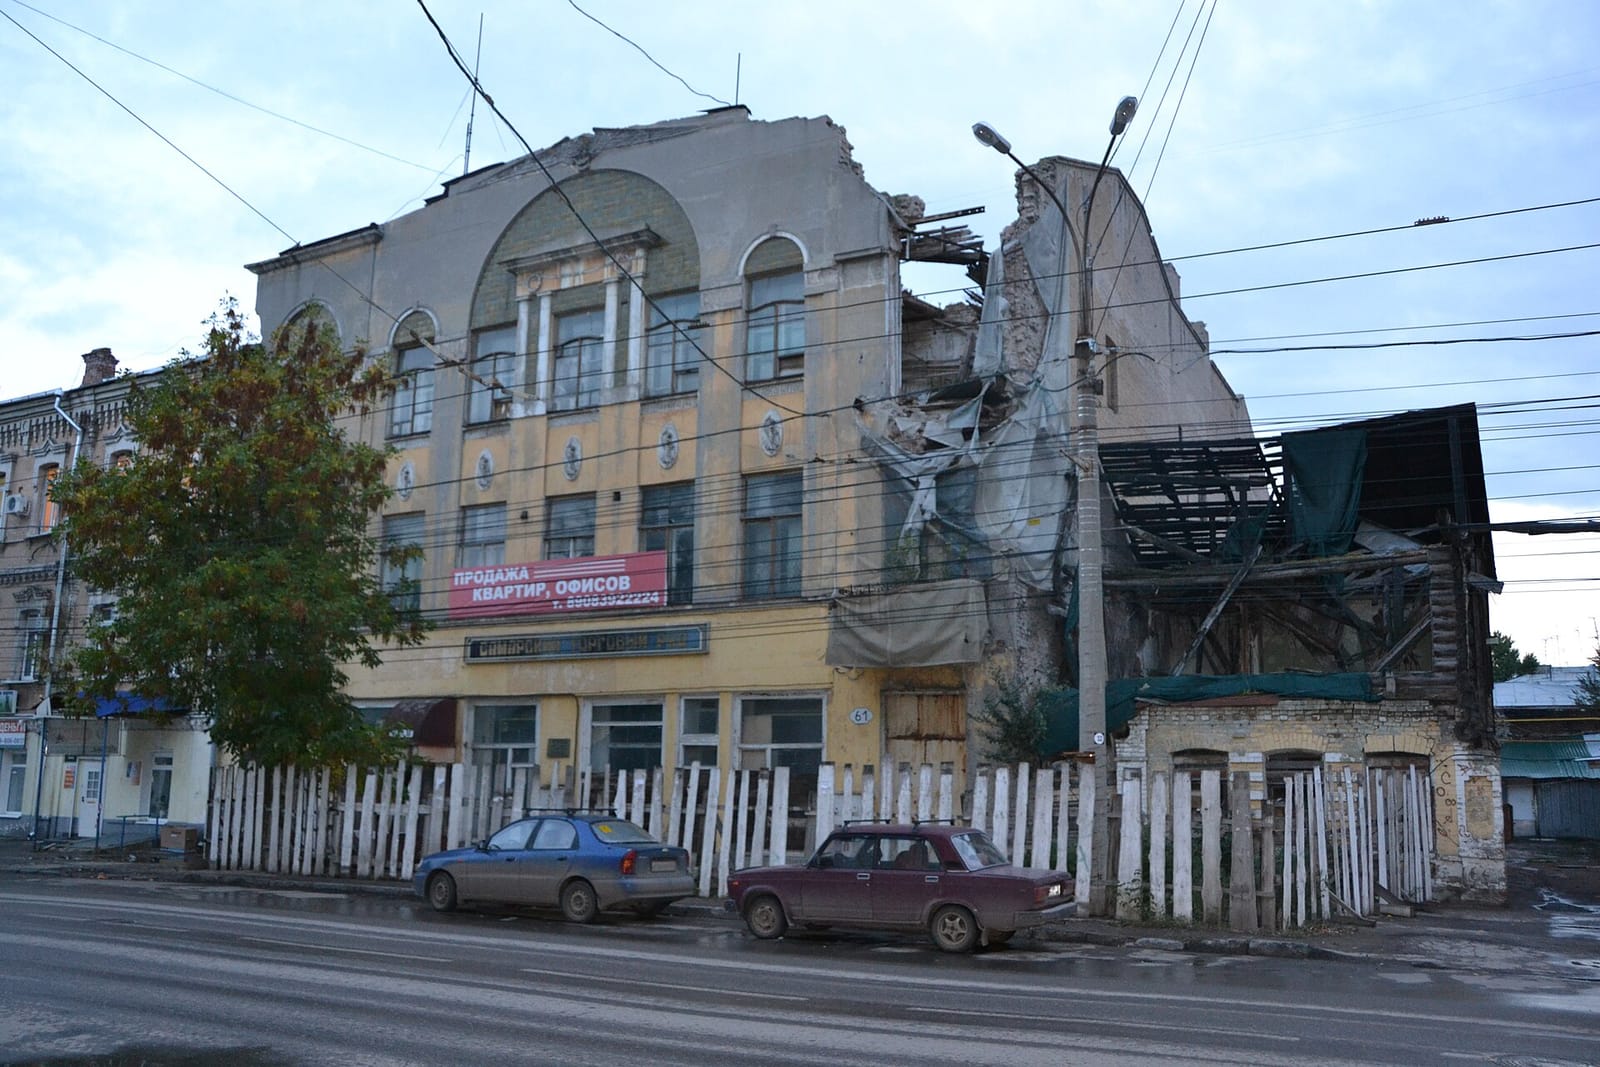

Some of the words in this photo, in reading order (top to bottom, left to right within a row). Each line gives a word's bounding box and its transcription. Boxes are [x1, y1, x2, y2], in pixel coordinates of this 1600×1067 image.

[454, 567, 529, 585] ПРОДАЖА
[473, 581, 551, 602] КВАРТИР,
[556, 575, 631, 595] ОФИСОВ
[479, 637, 561, 657] САМАРСК
[855, 710, 868, 722] 61
